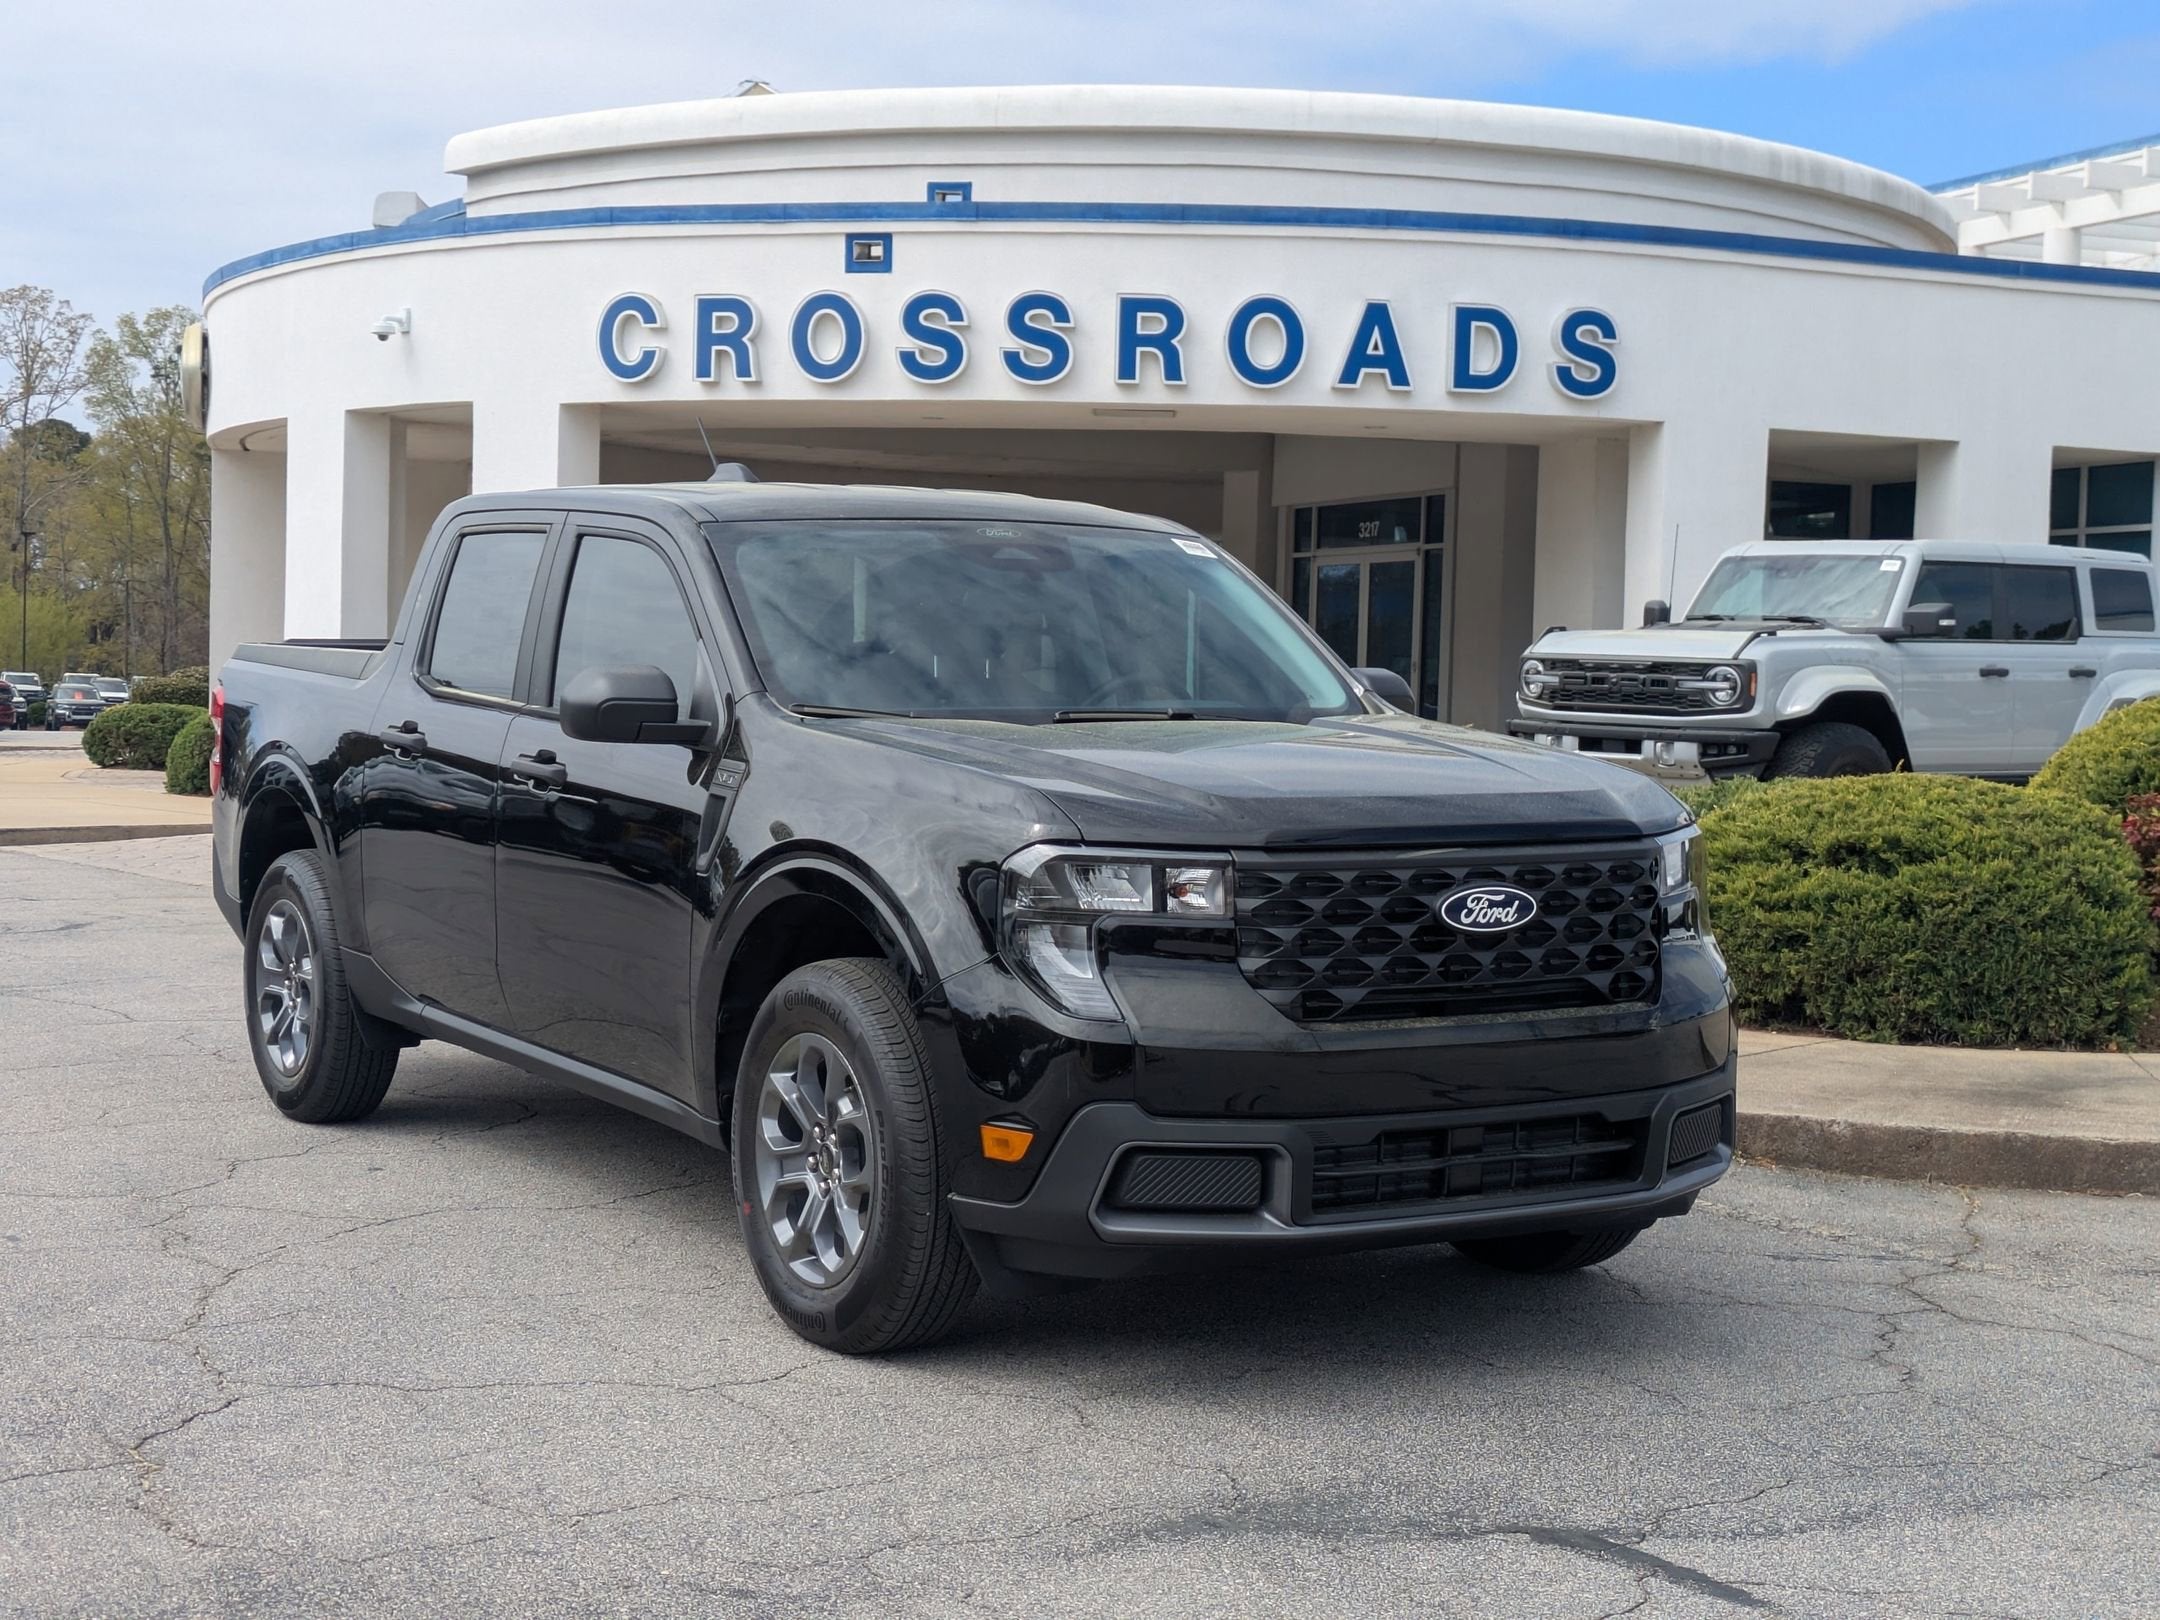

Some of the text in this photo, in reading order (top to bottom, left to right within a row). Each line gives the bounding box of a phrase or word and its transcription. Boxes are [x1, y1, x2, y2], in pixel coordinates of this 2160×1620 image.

[597, 291, 1620, 400] CROSSROADS
[1358, 520, 1380, 538] 3217
[1559, 671, 1675, 693] FORD
[1460, 893, 1519, 924] Ford
[784, 988, 842, 1025] Continental
